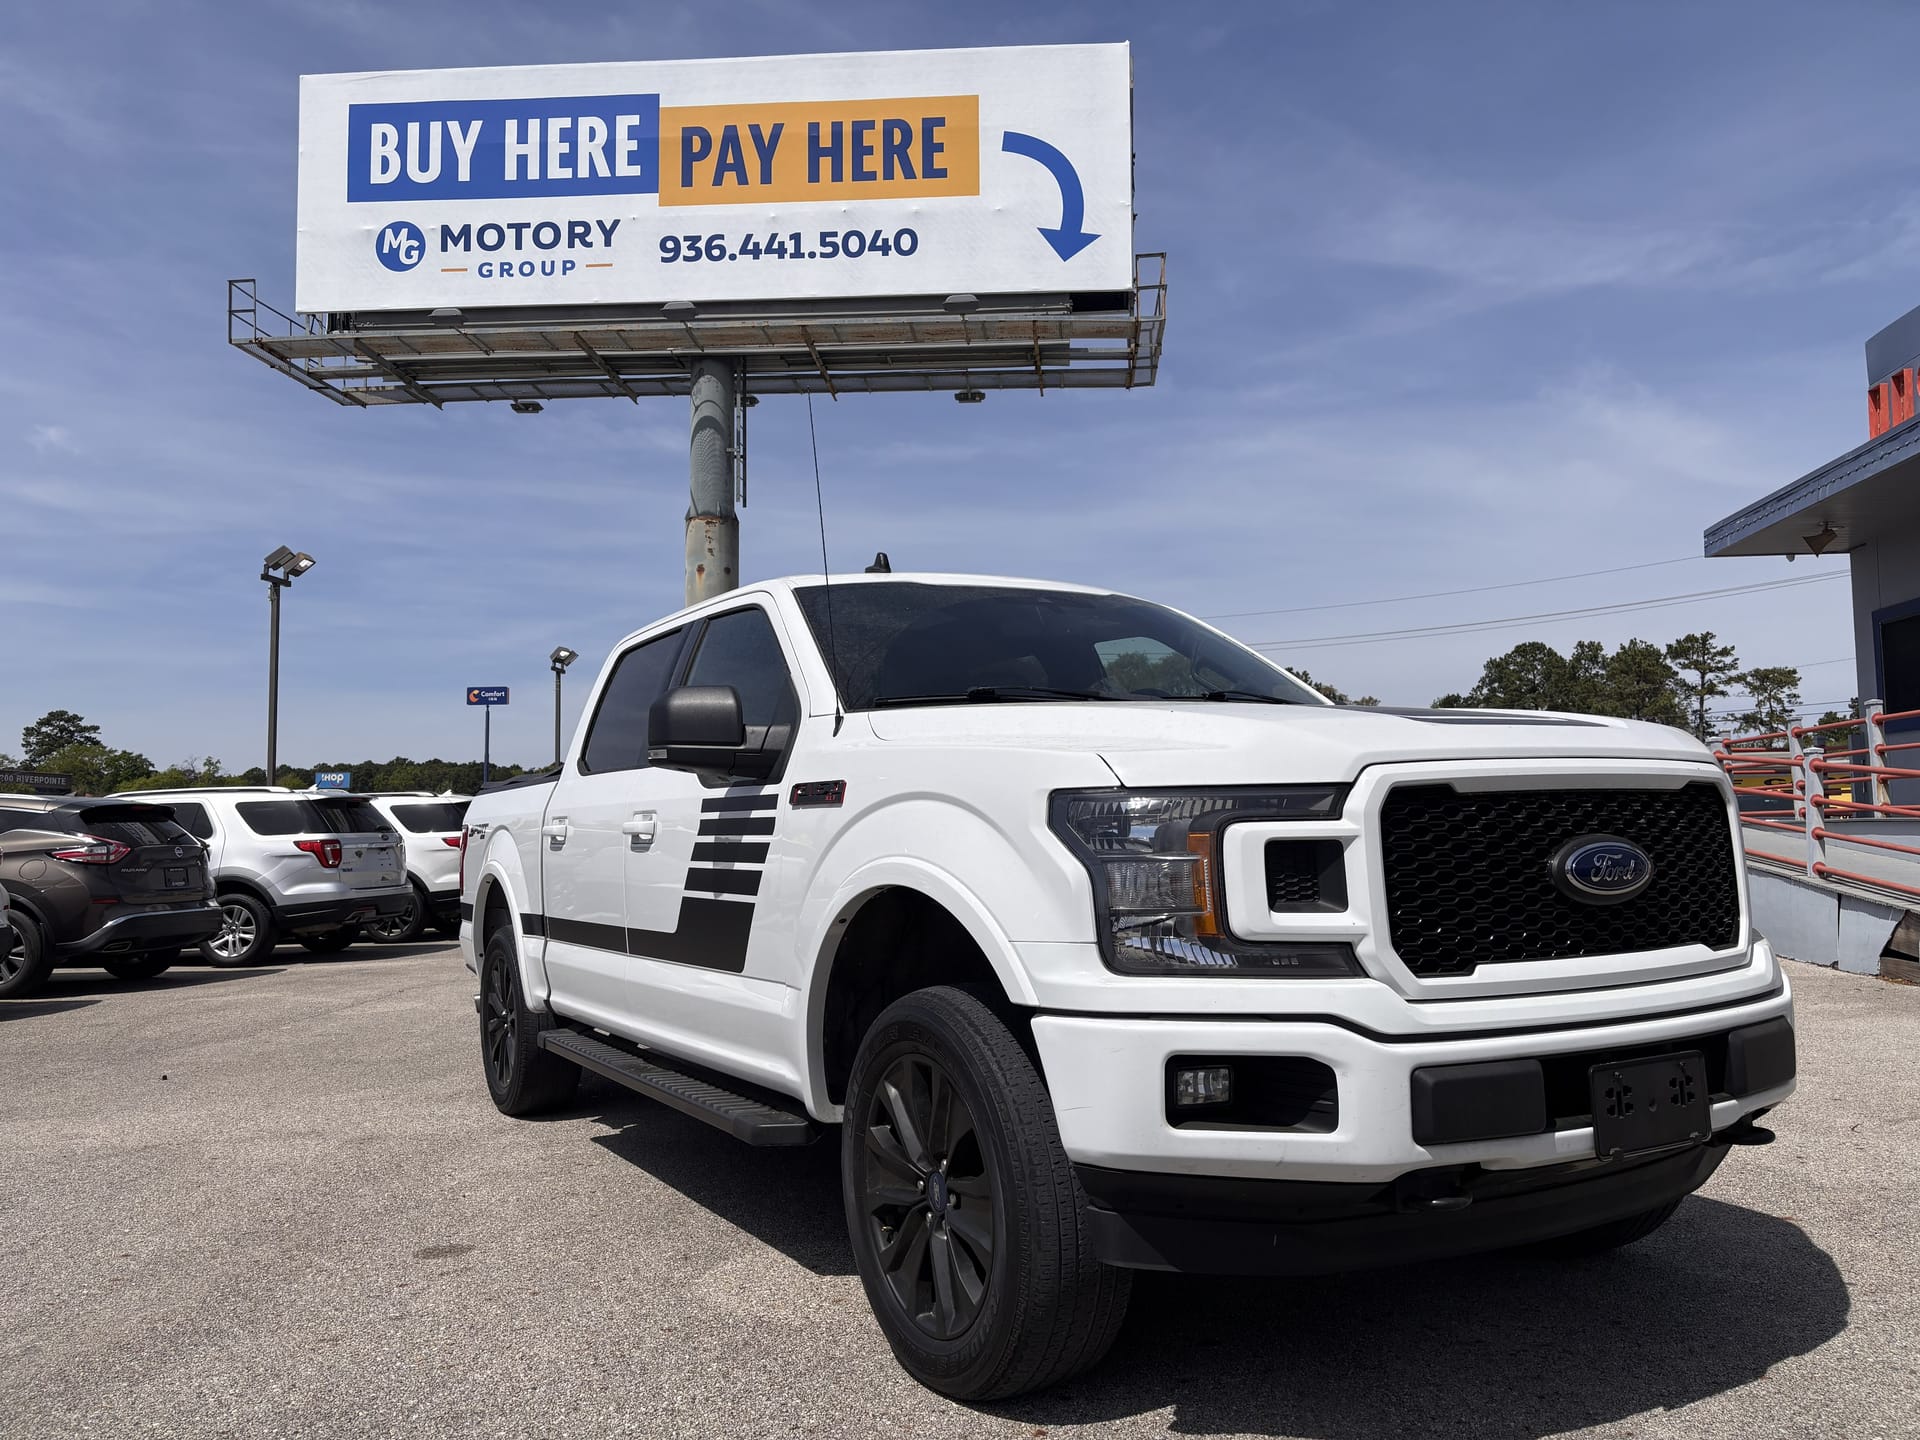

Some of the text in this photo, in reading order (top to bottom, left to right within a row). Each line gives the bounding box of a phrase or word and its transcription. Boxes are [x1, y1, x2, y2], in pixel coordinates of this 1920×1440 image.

[370, 114, 948, 187] BUY HERE PAY HERE
[382, 228, 420, 265] MG
[440, 218, 621, 252] MOTORY
[659, 227, 919, 264] 936.441.5040
[477, 259, 576, 279] GROUP
[16, 774, 67, 785] RIVERPOINTE
[1590, 853, 1635, 882] Ford
